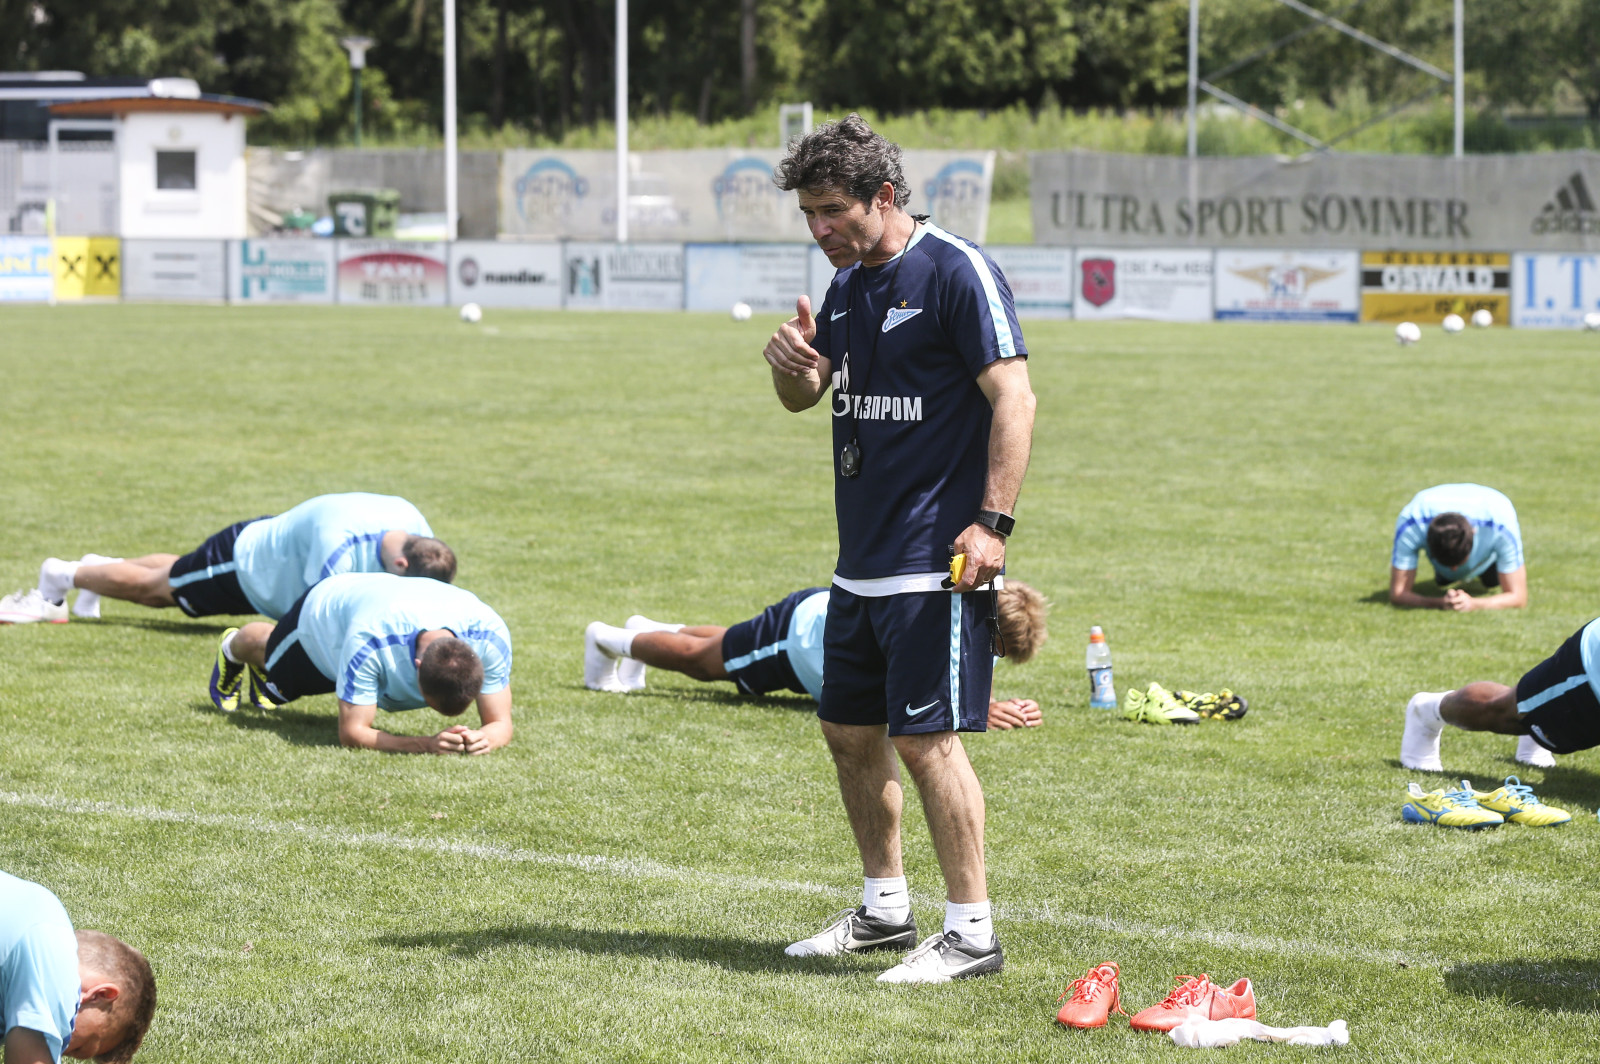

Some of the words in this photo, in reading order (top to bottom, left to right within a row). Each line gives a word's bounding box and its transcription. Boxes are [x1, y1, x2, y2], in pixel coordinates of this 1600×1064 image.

[1050, 191, 1166, 235] ULTRA
[1174, 194, 1291, 239] SPORT
[1300, 192, 1472, 239] SOMMER
[1381, 266, 1495, 291] OSWALD
[851, 394, 923, 421] АЗПРОМ
